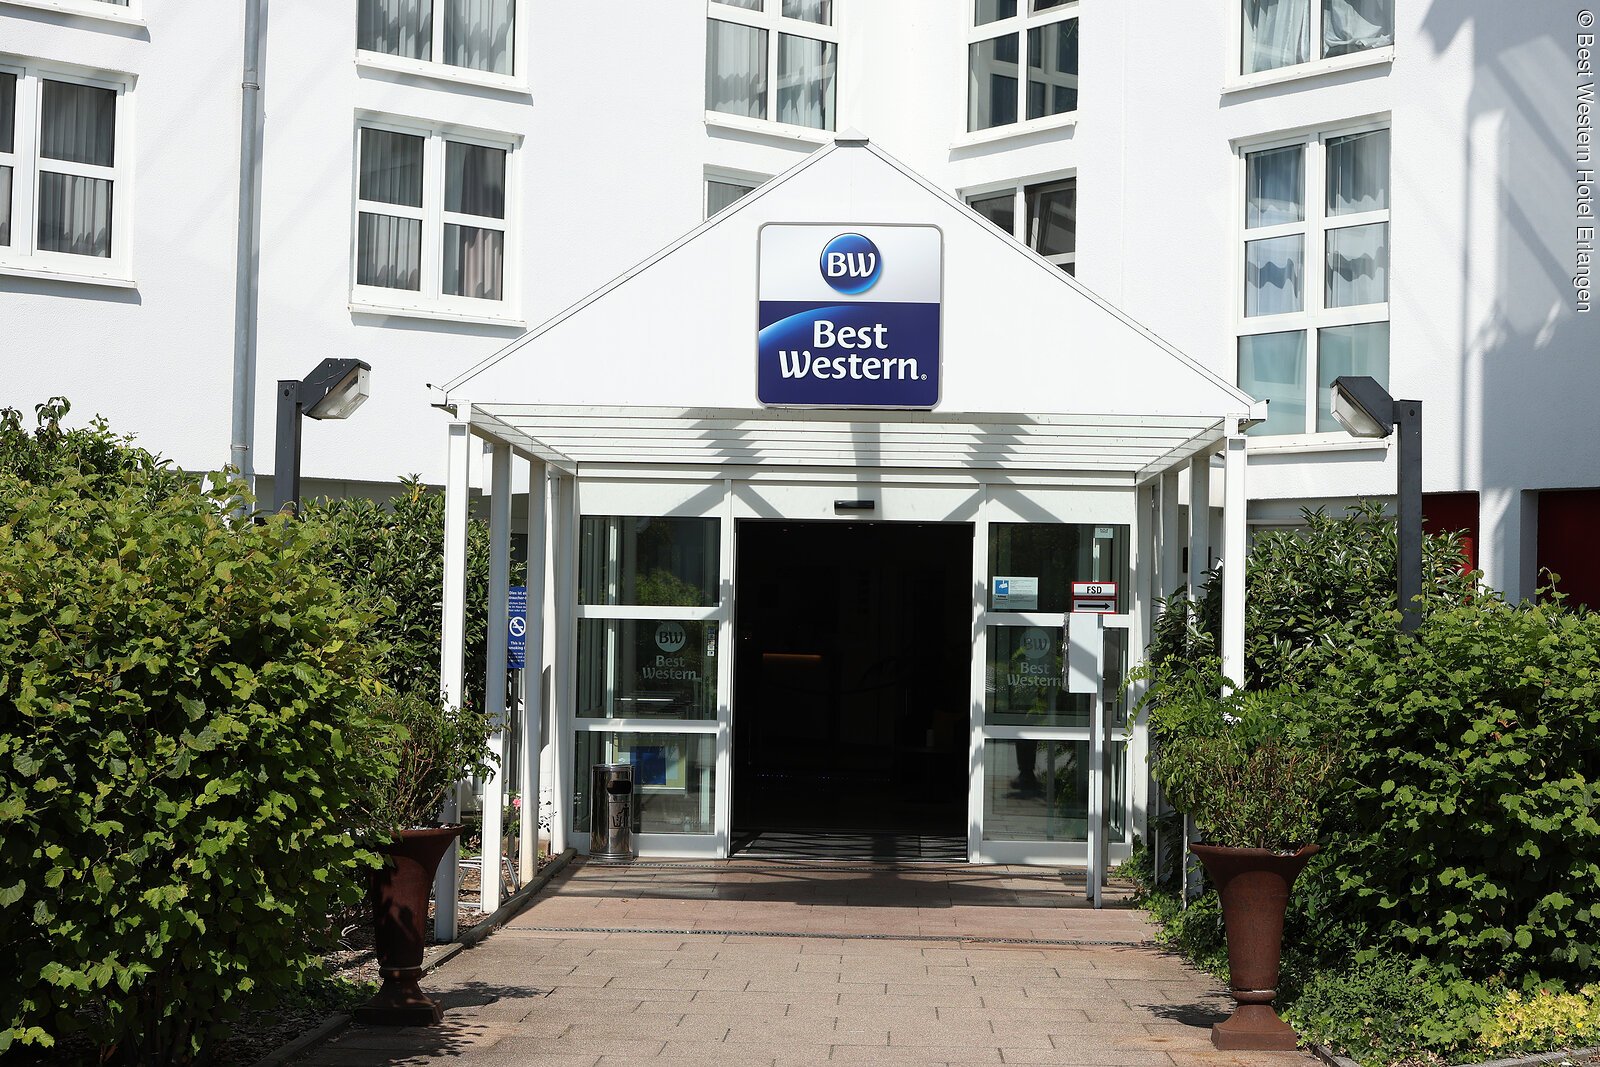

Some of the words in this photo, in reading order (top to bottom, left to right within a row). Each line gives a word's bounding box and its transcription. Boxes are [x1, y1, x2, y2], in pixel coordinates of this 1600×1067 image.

[827, 252, 875, 278] BW
[813, 320, 888, 349] Best
[1086, 586, 1102, 594] FSD
[659, 631, 682, 644] BW
[1024, 637, 1047, 650] BW
[656, 655, 685, 667] Best
[642, 667, 697, 680] Western
[1020, 662, 1050, 674] Best
[1007, 674, 1062, 686] Western
